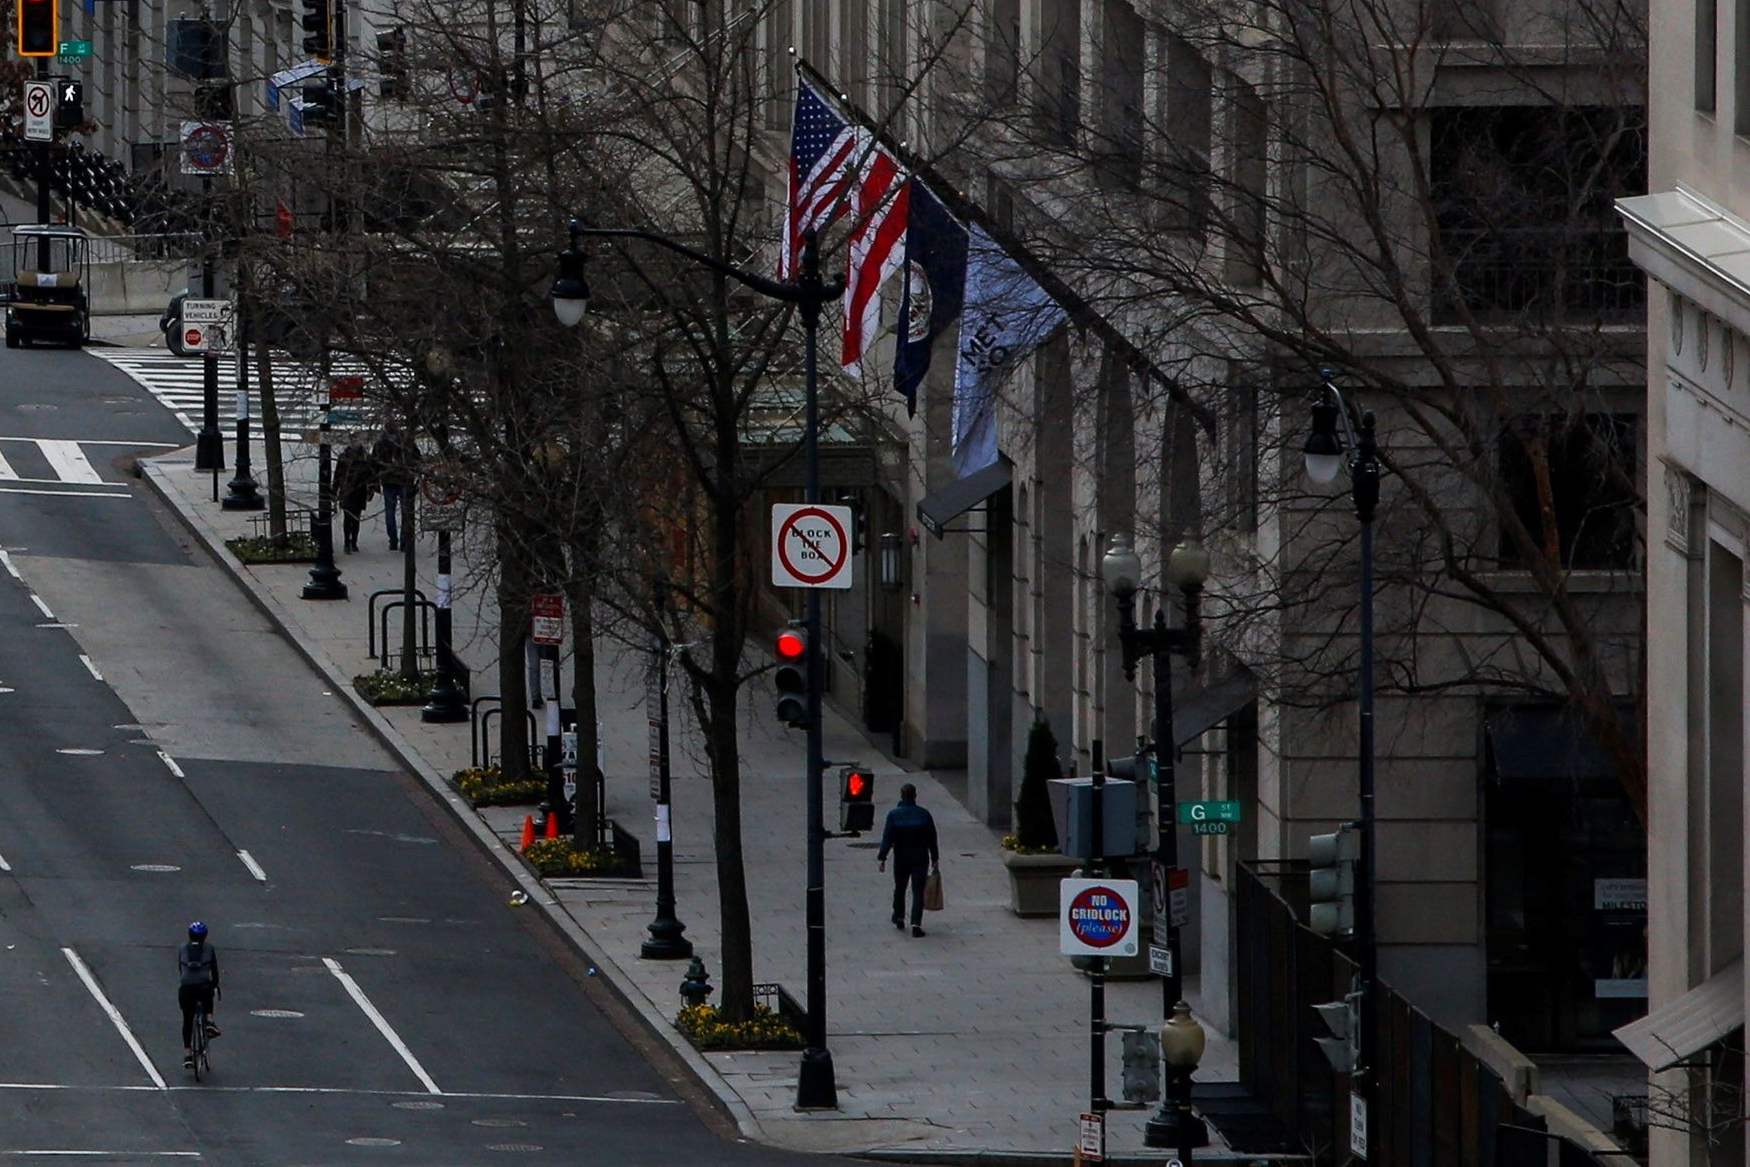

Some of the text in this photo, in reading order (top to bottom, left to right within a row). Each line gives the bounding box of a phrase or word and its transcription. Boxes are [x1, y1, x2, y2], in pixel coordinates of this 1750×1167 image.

[60, 43, 69, 54] F
[59, 56, 82, 64] 1400
[1191, 804, 1206, 820] G
[1193, 822, 1227, 834] 1400
[1091, 895, 1108, 907] NO
[1072, 908, 1128, 922] GRIDLOCK
[1076, 922, 1123, 935] (please)
